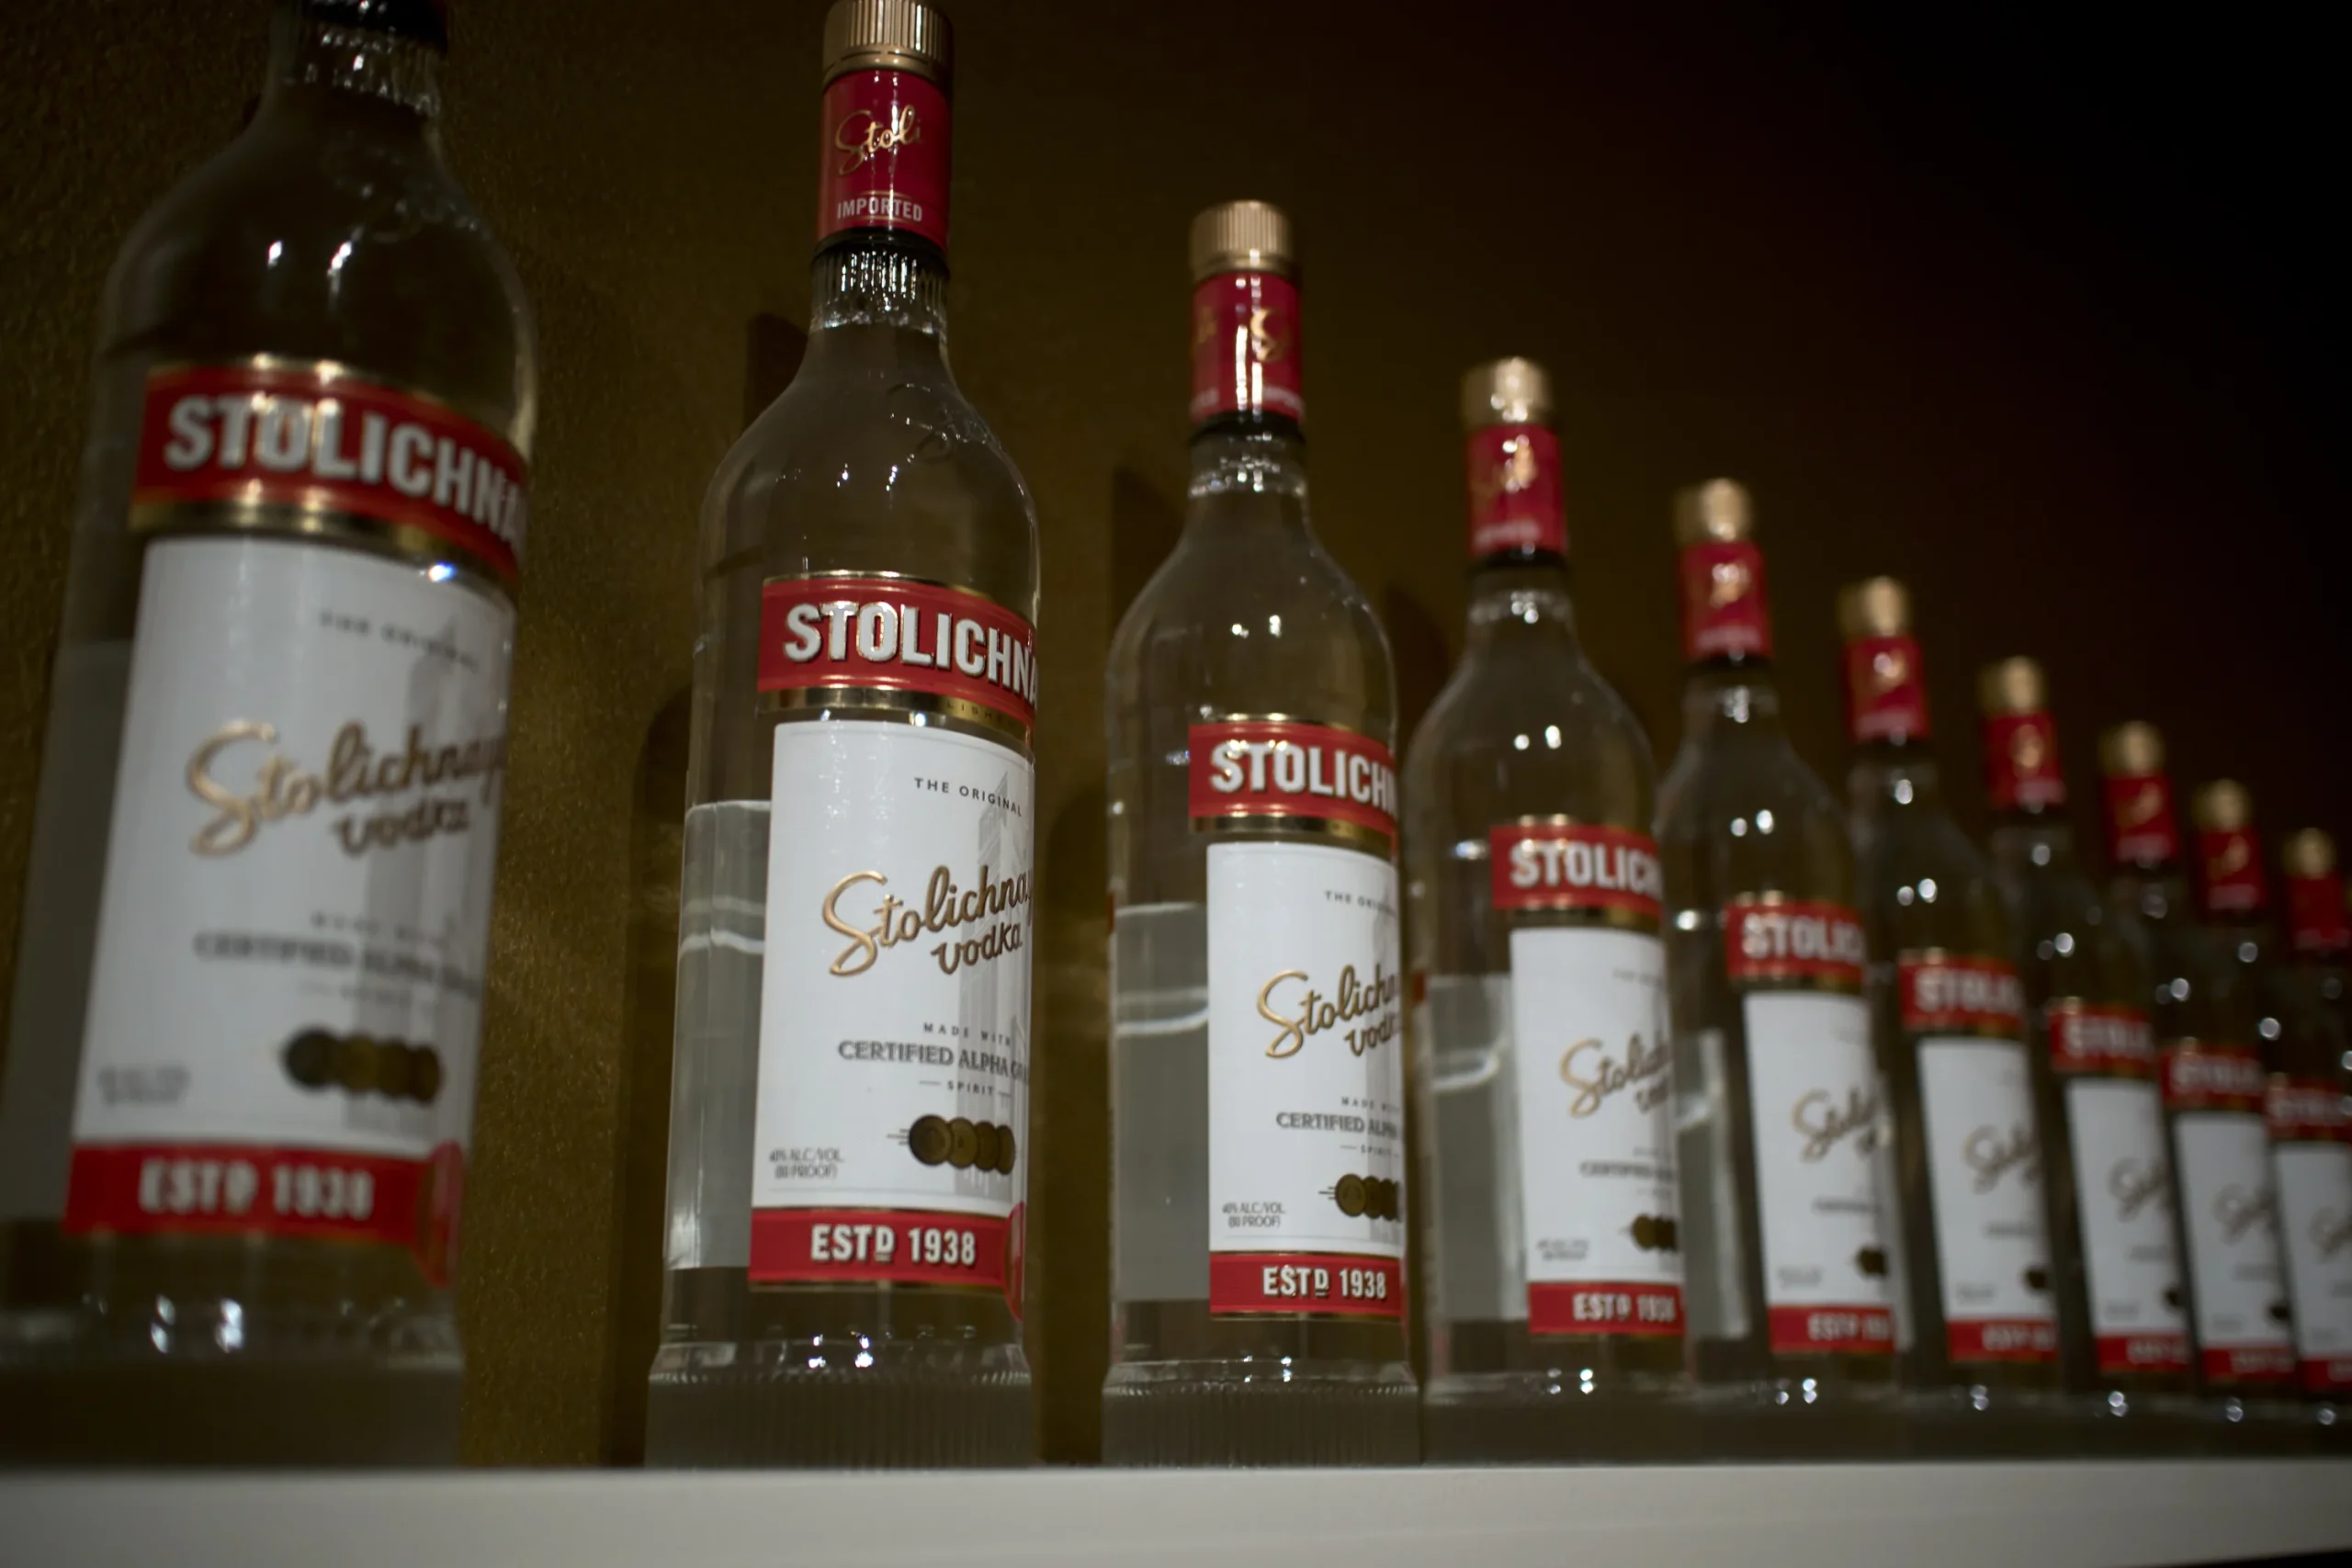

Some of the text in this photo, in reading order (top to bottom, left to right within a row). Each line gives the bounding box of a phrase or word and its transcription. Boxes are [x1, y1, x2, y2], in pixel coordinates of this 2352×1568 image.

[837, 196, 922, 222] IMPORTED
[914, 777, 1023, 818] THE ORIGINAL
[930, 921, 1023, 975] vodka
[922, 1021, 970, 1039] MADE
[837, 1040, 954, 1066] CERTIFIED
[957, 1049, 1009, 1078] ALPHA
[946, 1080, 995, 1097] SPIRIT
[1275, 1111, 1365, 1134] CERTIFIED
[810, 1224, 977, 1267] ESTD 1938
[1262, 1266, 1387, 1300] ESTD 1938
